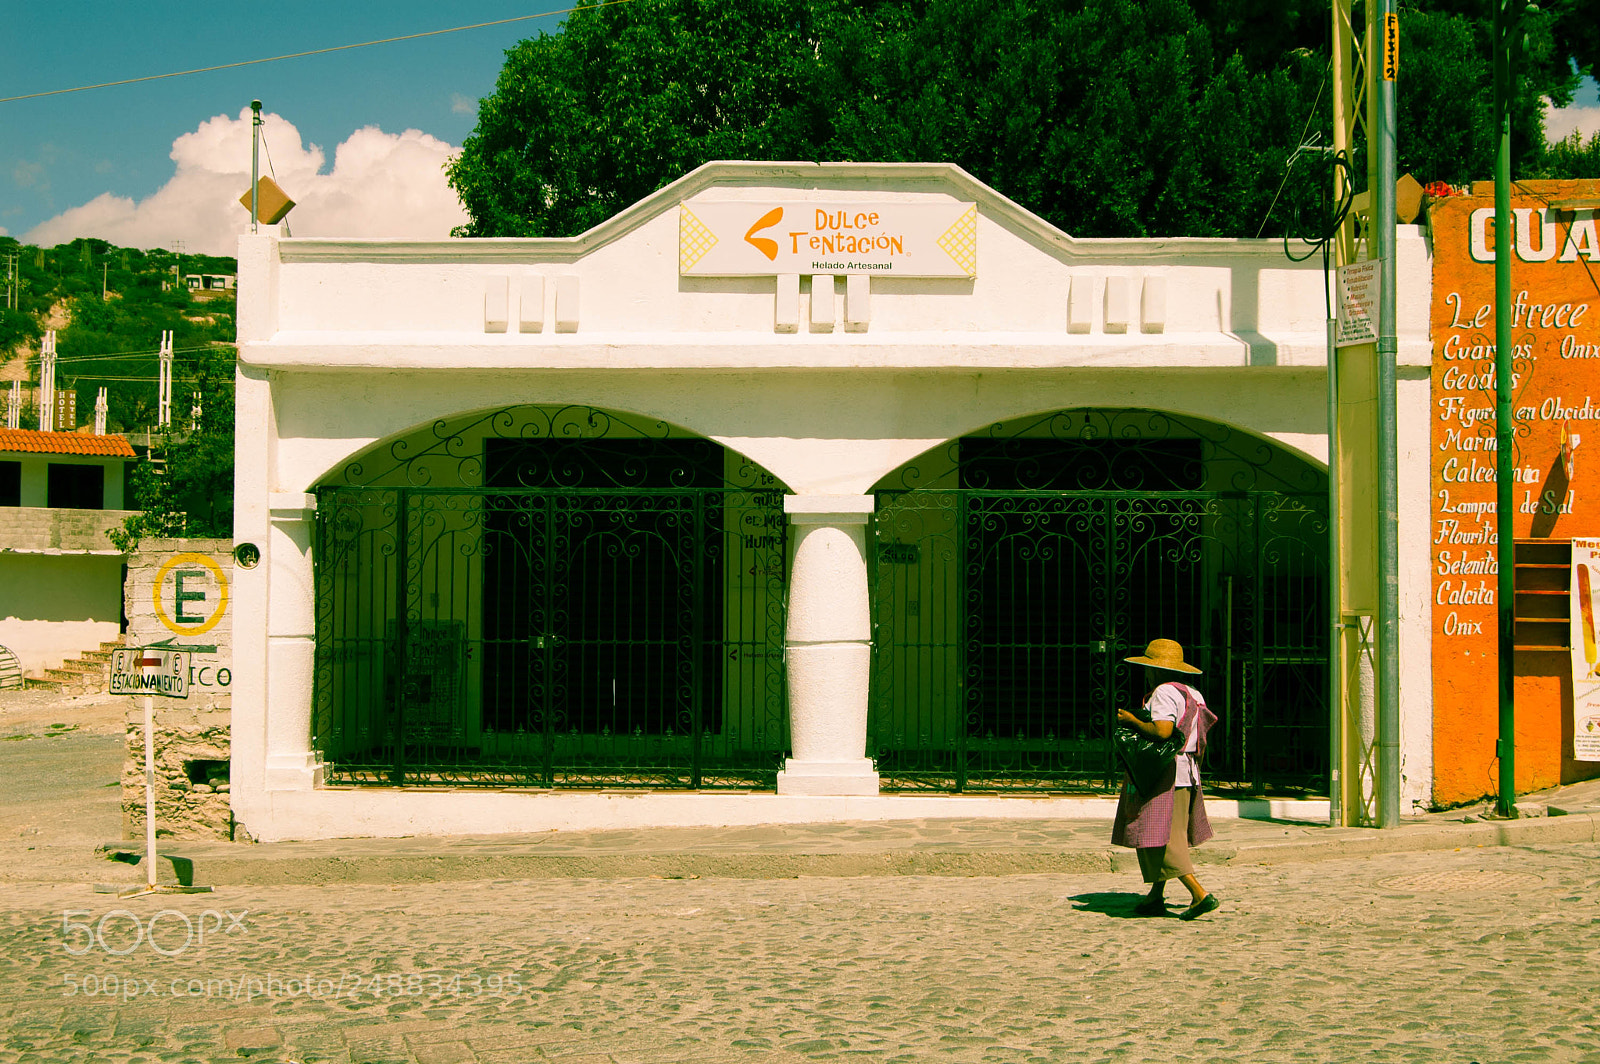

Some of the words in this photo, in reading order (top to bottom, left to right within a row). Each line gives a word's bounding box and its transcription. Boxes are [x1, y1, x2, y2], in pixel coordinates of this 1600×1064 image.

[812, 261, 845, 270] Helado
[847, 261, 892, 270] Artesanal
[1446, 293, 1491, 329] Le
[1510, 290, 1588, 329] frece
[1560, 335, 1600, 359] Onix
[1443, 363, 1521, 390] Geods
[1516, 406, 1536, 420] en
[1440, 427, 1516, 451] Marml
[760, 472, 774, 486] te
[1443, 458, 1540, 484] Calcenia
[1520, 490, 1539, 514] de
[1541, 490, 1575, 514] Sal
[1438, 551, 1498, 576] Selenita
[175, 570, 206, 623] E
[1437, 581, 1494, 605] Calcita
[1444, 612, 1482, 636] Onix
[112, 673, 183, 693] ESTACIONAMIENTO
